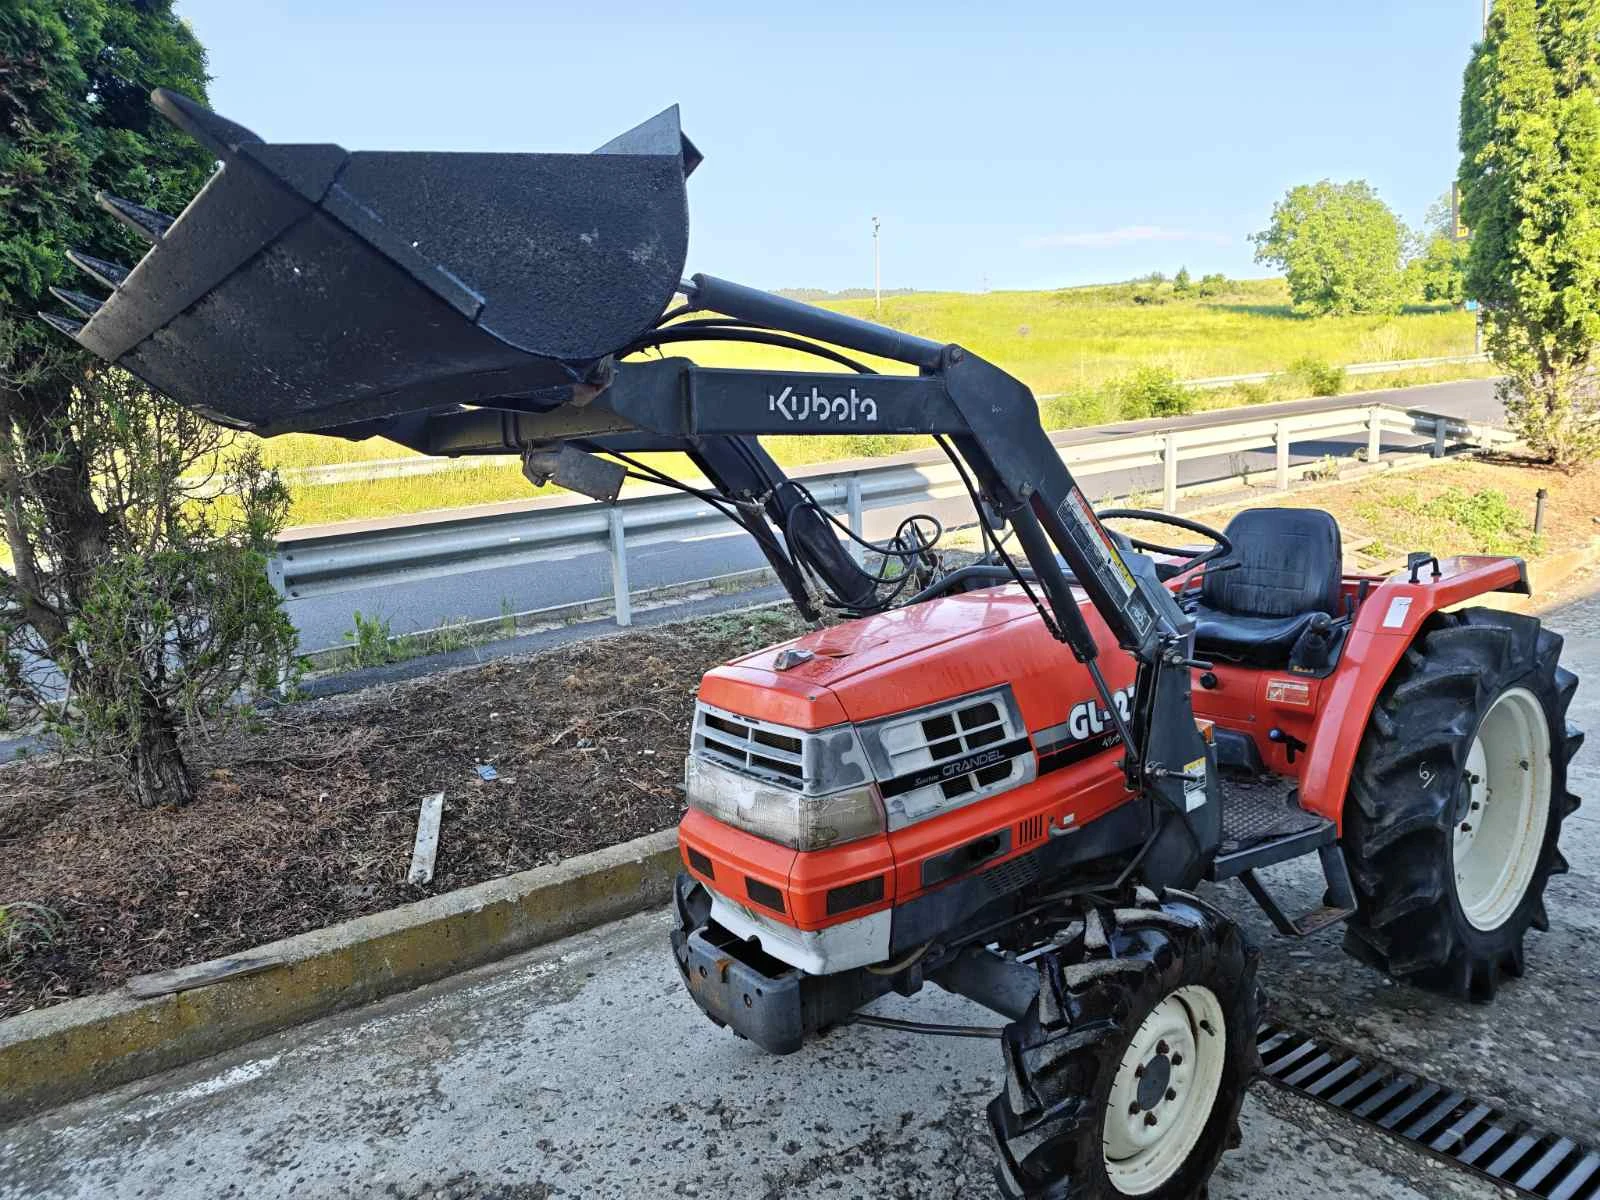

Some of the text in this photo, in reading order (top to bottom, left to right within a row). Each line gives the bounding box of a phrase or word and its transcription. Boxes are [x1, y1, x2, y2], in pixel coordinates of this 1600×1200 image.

[769, 386, 878, 421] Kubota
[1069, 685, 1135, 740] GL-2
[942, 749, 1005, 777] GRANDEL
